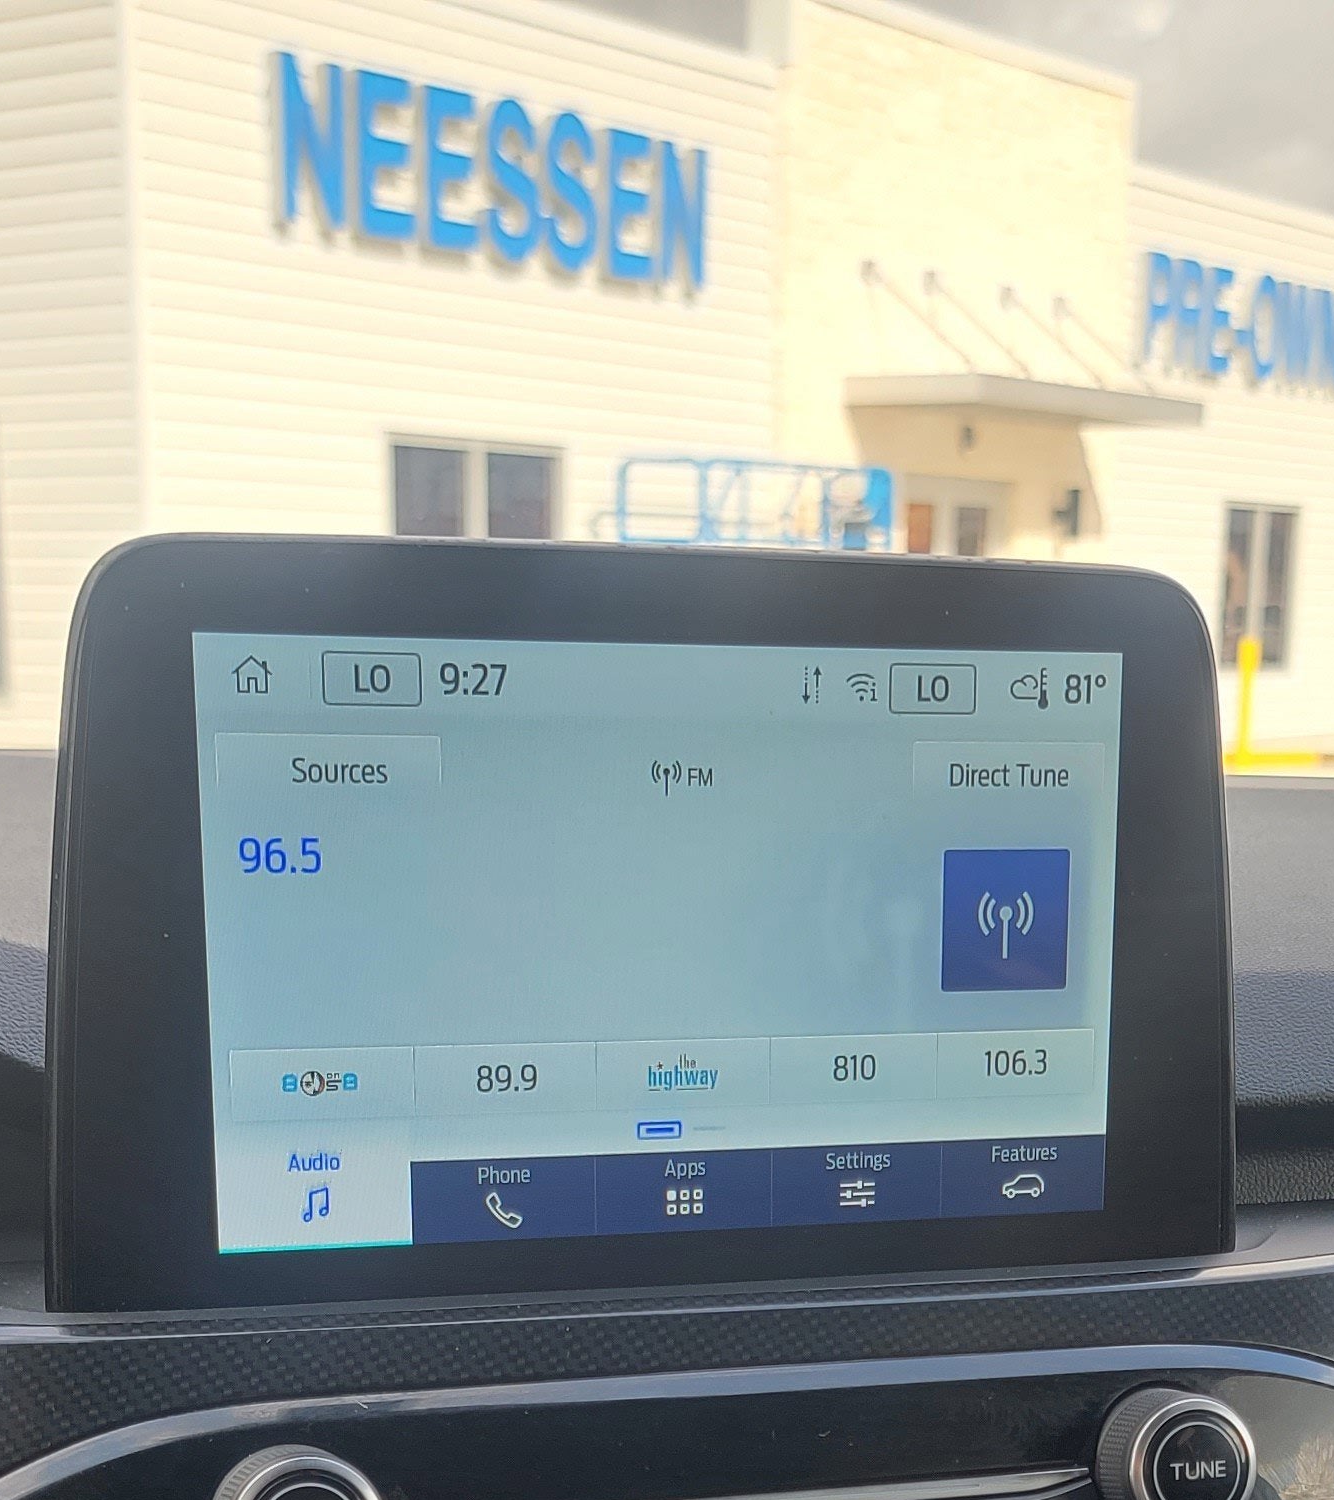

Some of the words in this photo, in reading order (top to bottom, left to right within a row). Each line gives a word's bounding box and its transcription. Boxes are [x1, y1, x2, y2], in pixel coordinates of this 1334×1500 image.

[278, 50, 708, 292] NEESSEN
[353, 663, 392, 694] LO
[439, 662, 508, 697] 9:27
[916, 674, 950, 703] LO
[1064, 674, 1108, 705] 81°
[290, 756, 389, 785] Sources
[687, 766, 714, 787] FM
[948, 762, 1011, 788] Direct
[1015, 763, 1070, 788] Tune
[237, 836, 323, 875] 96.5
[832, 1053, 877, 1082] 810
[983, 1048, 1049, 1077] 106.3
[475, 1062, 539, 1094] 89.9
[647, 1064, 719, 1091] highway
[287, 1152, 341, 1173] Audio
[824, 1149, 892, 1174] Settings
[990, 1142, 1058, 1163] Features
[477, 1164, 532, 1185] Phone
[663, 1157, 707, 1181] Apps
[1169, 1459, 1227, 1481] TUNE
